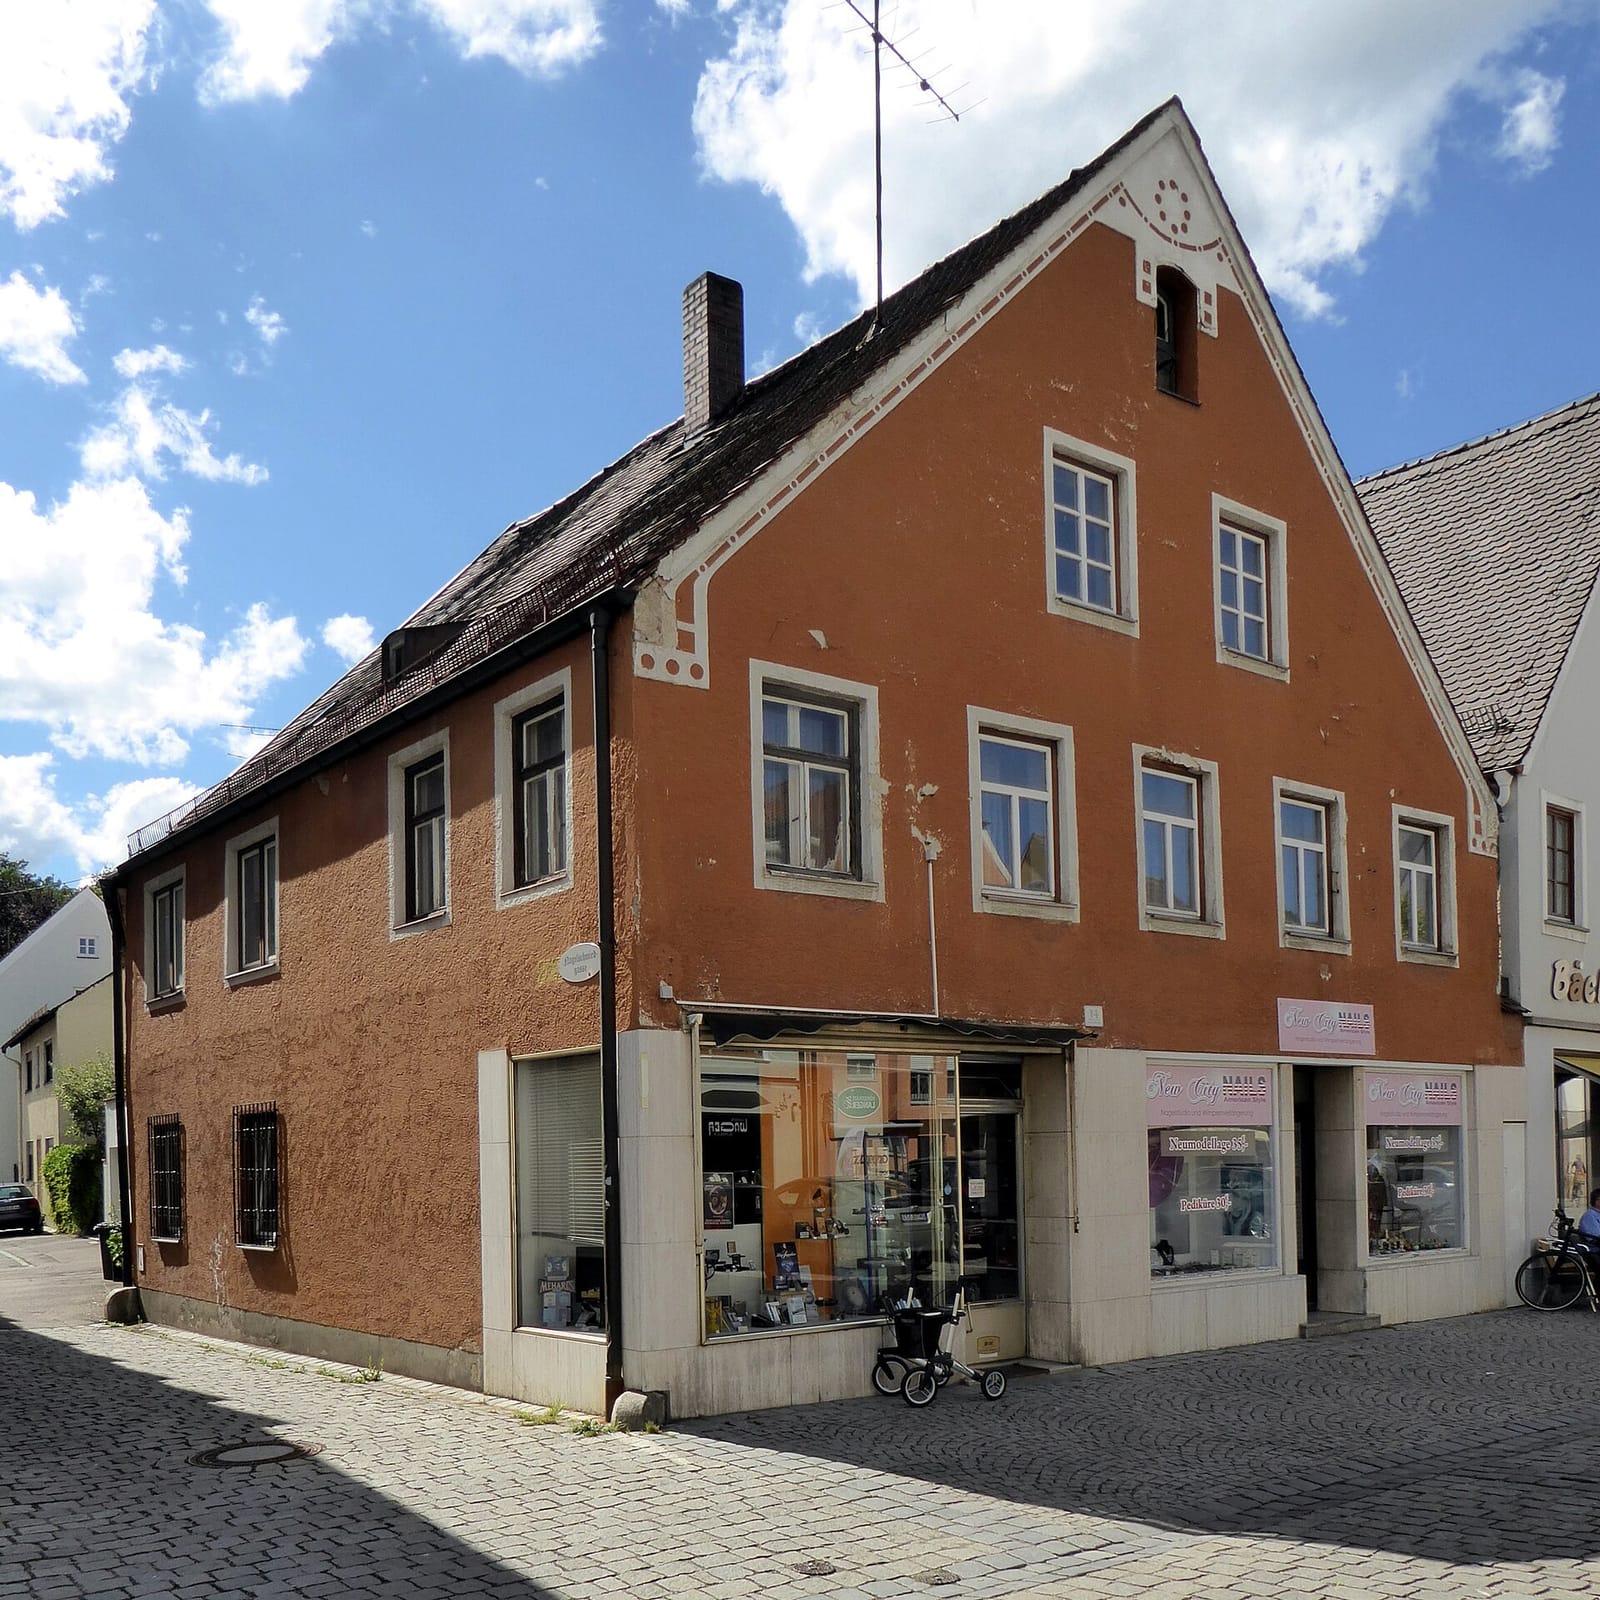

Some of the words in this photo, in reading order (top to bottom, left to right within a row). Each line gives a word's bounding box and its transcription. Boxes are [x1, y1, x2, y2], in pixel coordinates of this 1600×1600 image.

[1284, 1006, 1311, 1028] New
[1312, 1011, 1337, 1034] City
[1338, 1011, 1371, 1029] NAILS
[1146, 1071, 1183, 1099] New
[1187, 1075, 1220, 1105] City
[1222, 1075, 1266, 1096] NAILS
[1369, 1077, 1396, 1101] New
[1398, 1081, 1424, 1107] City
[1424, 1081, 1457, 1100] NAILS
[1168, 1136, 1231, 1154] Neumodellage
[1180, 1197, 1215, 1212] Pediküre
